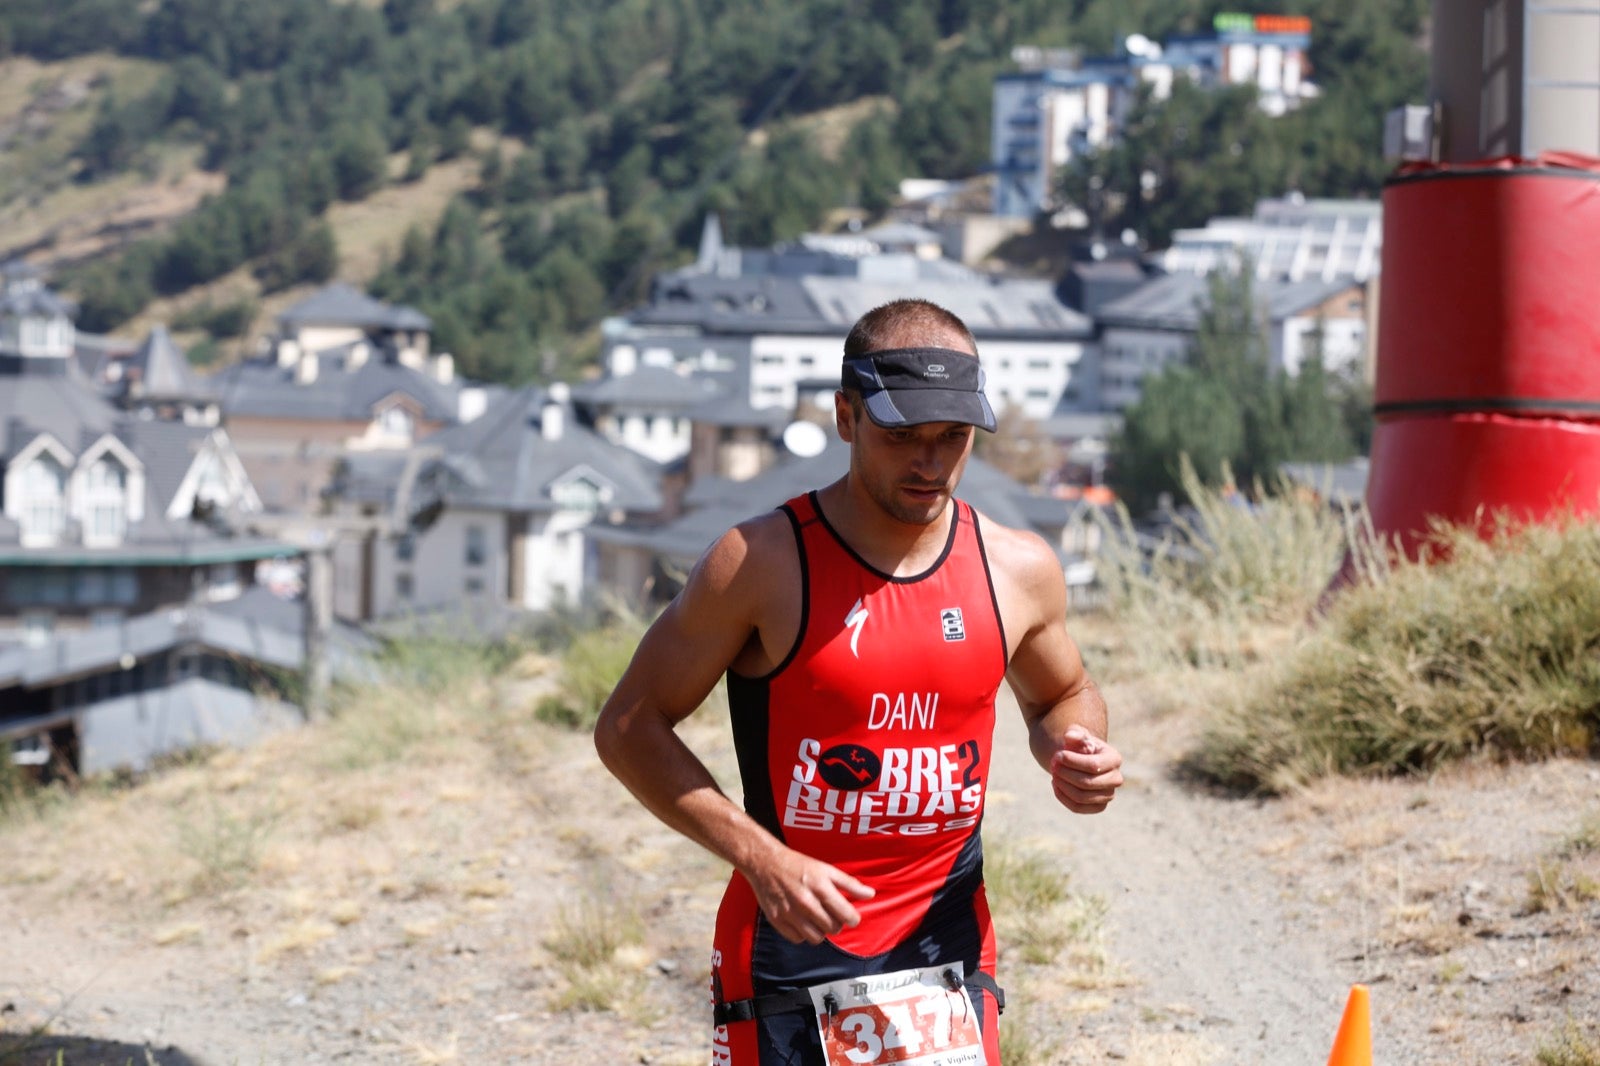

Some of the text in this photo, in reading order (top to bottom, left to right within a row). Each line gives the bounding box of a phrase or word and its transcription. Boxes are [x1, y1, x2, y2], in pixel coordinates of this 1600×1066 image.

[867, 692, 939, 731] DANI
[786, 780, 981, 817] RUEDAS
[841, 996, 953, 1064] 347
